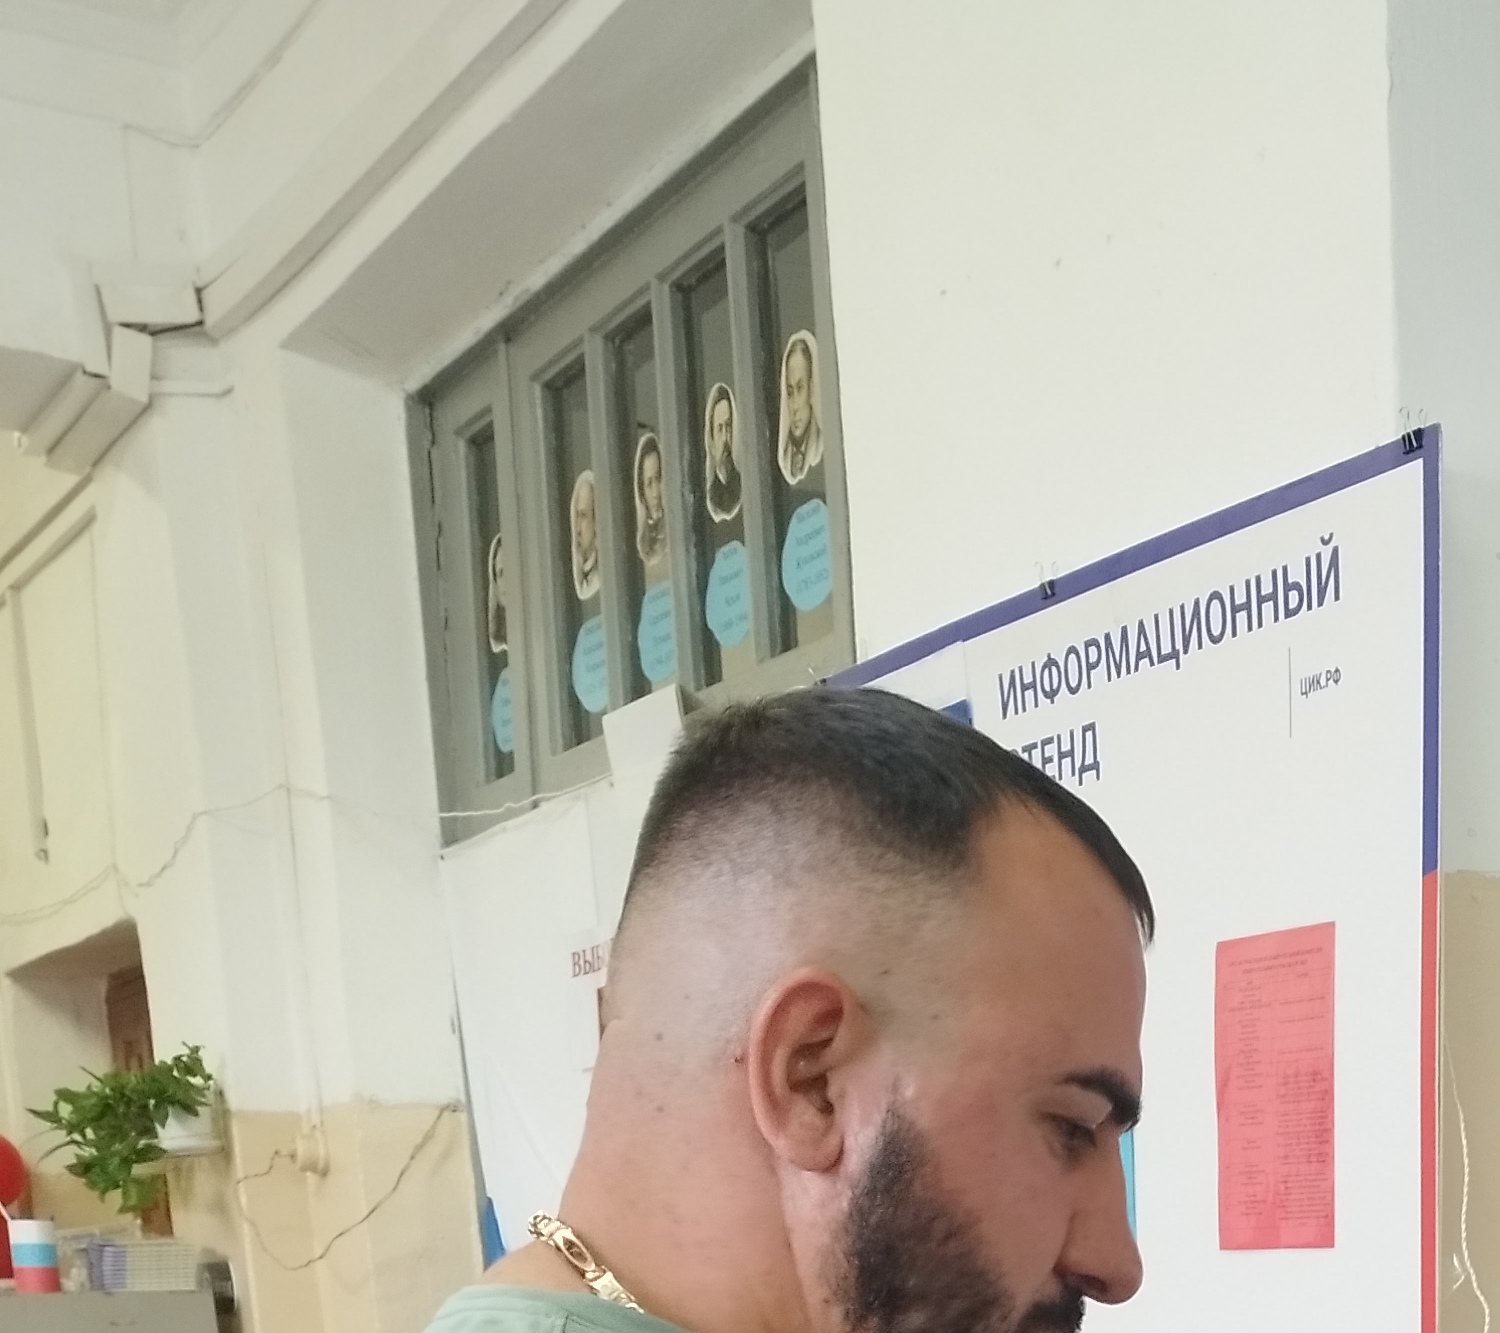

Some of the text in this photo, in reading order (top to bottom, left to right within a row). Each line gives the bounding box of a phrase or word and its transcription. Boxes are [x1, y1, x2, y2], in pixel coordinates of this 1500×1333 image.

[998, 532, 1341, 720] ИНФОРМАЦИОННЫЙ
[1301, 666, 1341, 699] ЦИК.РФ
[1009, 721, 1099, 787] ТЕНД
